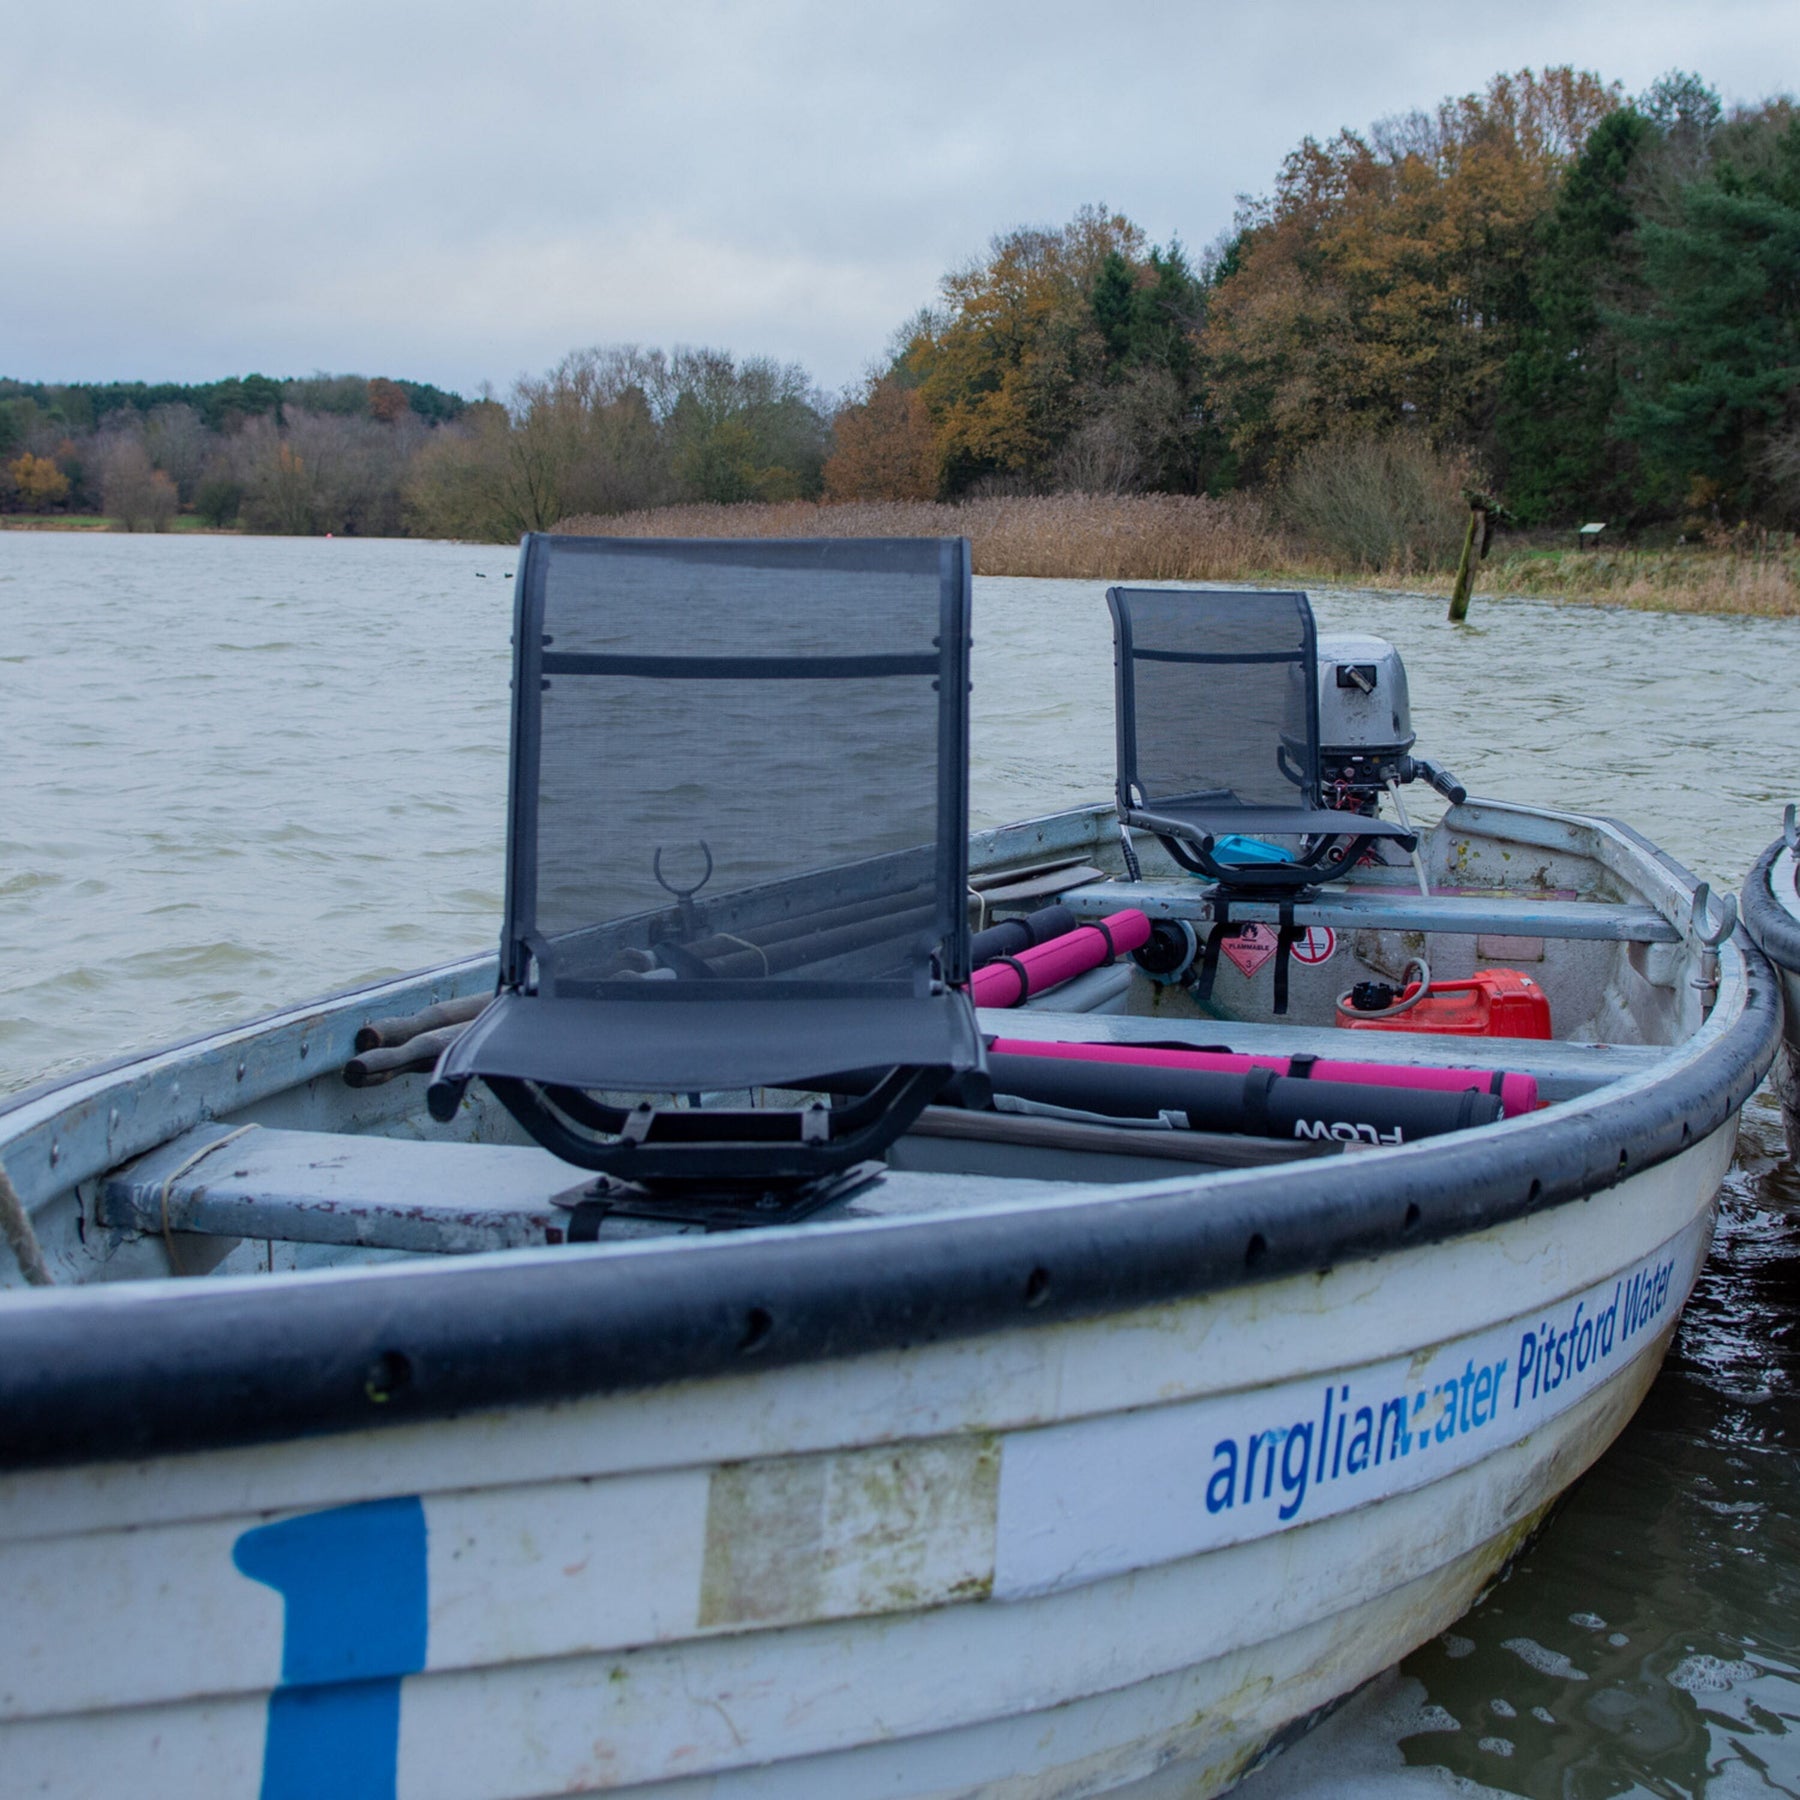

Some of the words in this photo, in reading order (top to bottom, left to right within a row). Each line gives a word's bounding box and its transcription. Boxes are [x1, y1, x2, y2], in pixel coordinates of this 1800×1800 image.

[1228, 943, 1270, 951] FLAMMABLE
[1246, 960, 1252, 968] 3
[1294, 1119, 1404, 1146] FLOW
[1514, 1281, 1621, 1408] Pitsford
[1622, 1258, 1675, 1341] Water
[231, 1494, 429, 1800] 1
